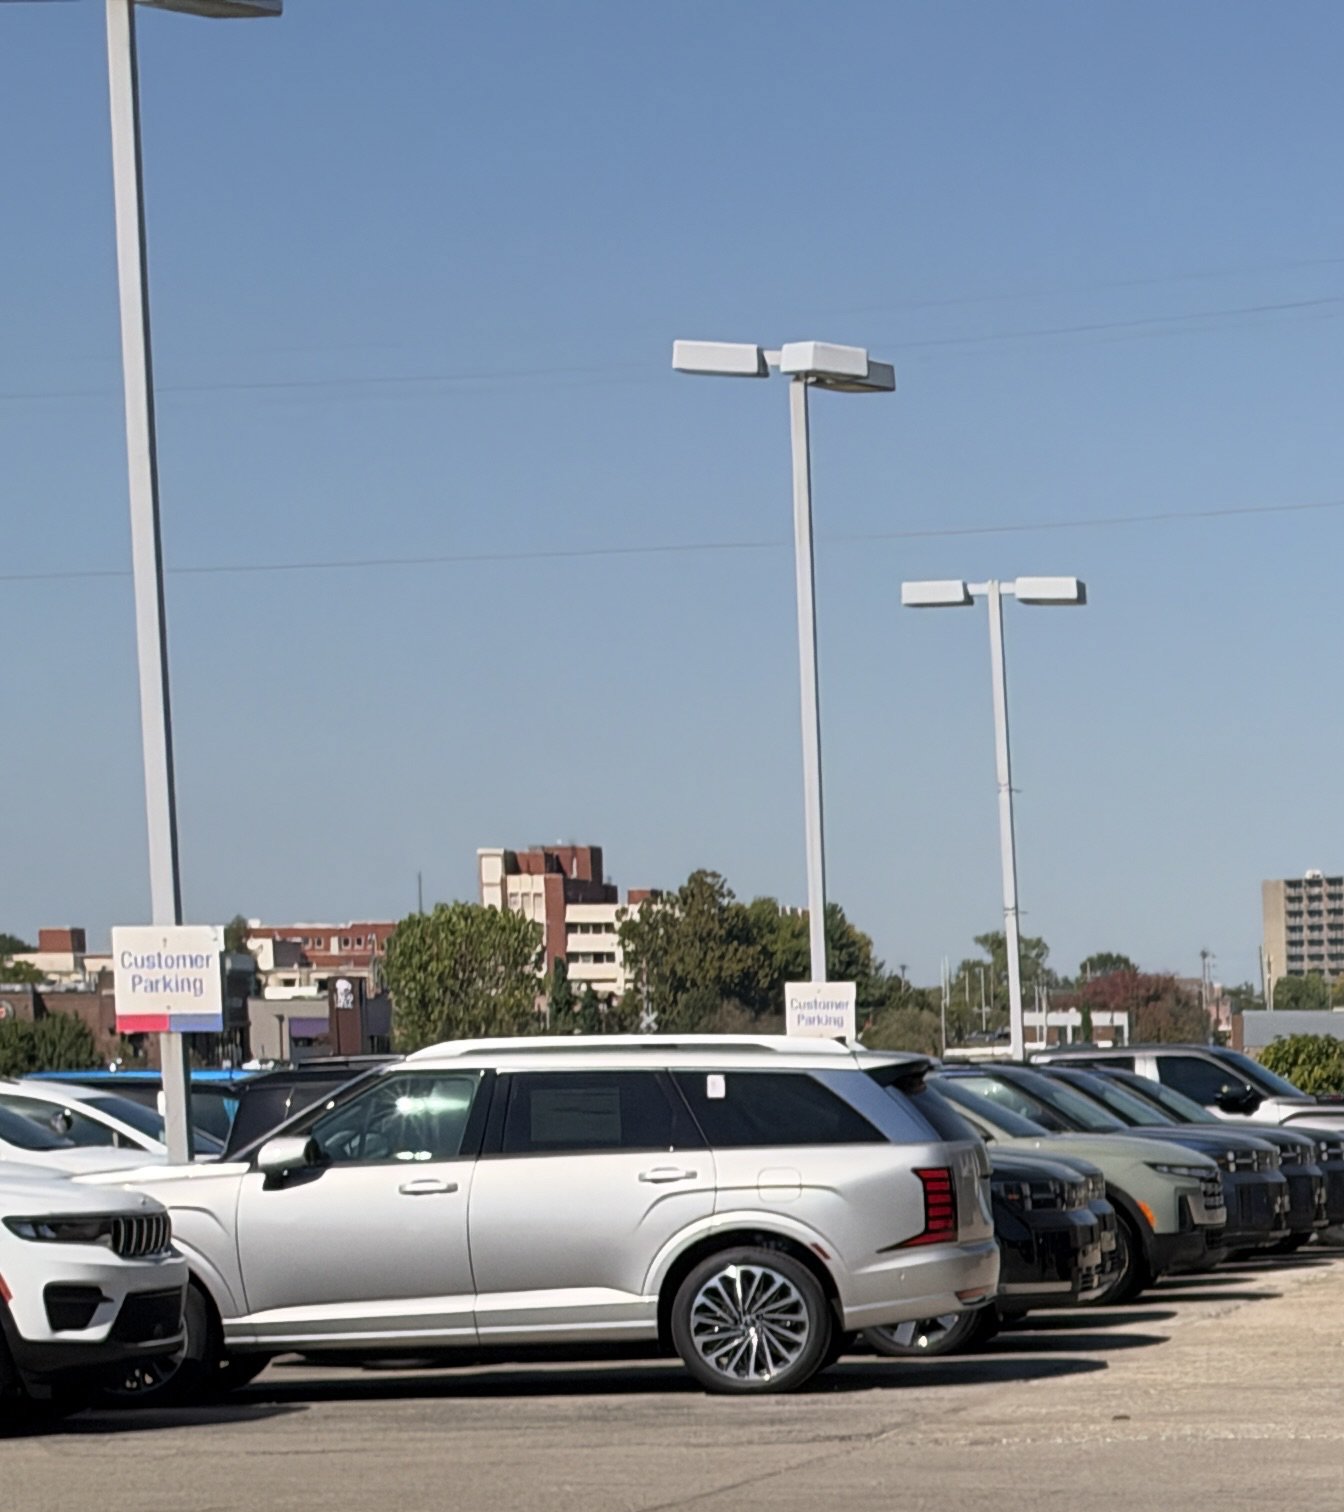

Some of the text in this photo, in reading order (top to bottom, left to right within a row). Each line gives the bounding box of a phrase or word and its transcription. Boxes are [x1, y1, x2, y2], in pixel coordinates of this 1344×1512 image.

[120, 950, 213, 969] Customer
[131, 973, 204, 997] Parking
[790, 997, 849, 1011] Customer
[797, 1013, 844, 1029] Parking
